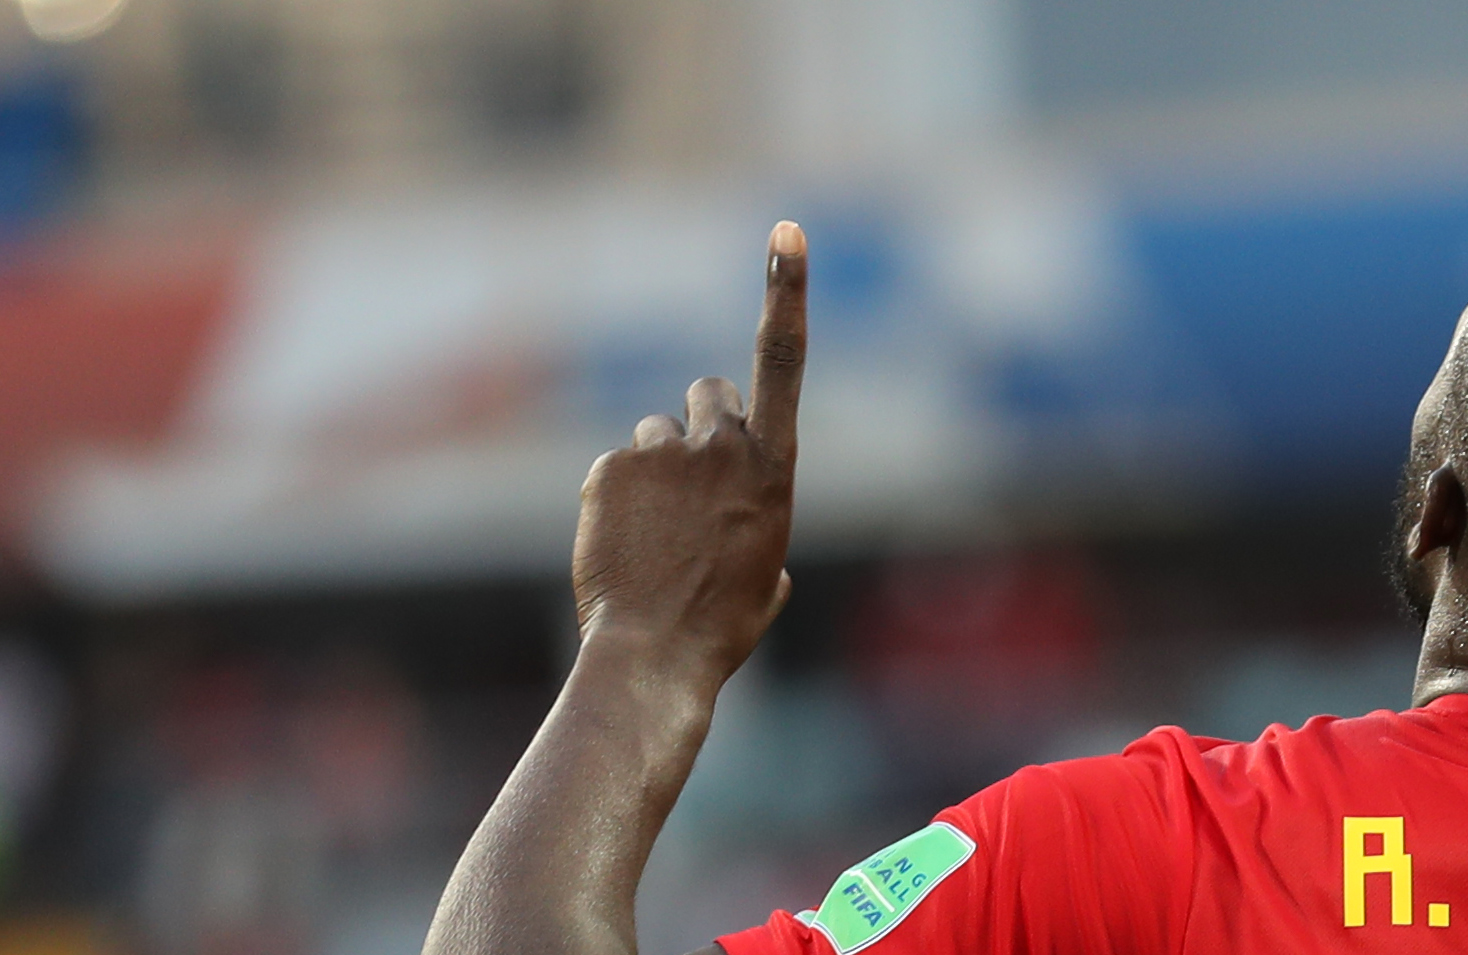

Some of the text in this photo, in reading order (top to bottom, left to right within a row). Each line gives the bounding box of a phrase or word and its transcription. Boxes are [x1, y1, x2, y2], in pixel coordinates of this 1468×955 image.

[867, 858, 910, 903] BALL
[1343, 816, 1450, 928] R.
[842, 882, 884, 929] FIFA
